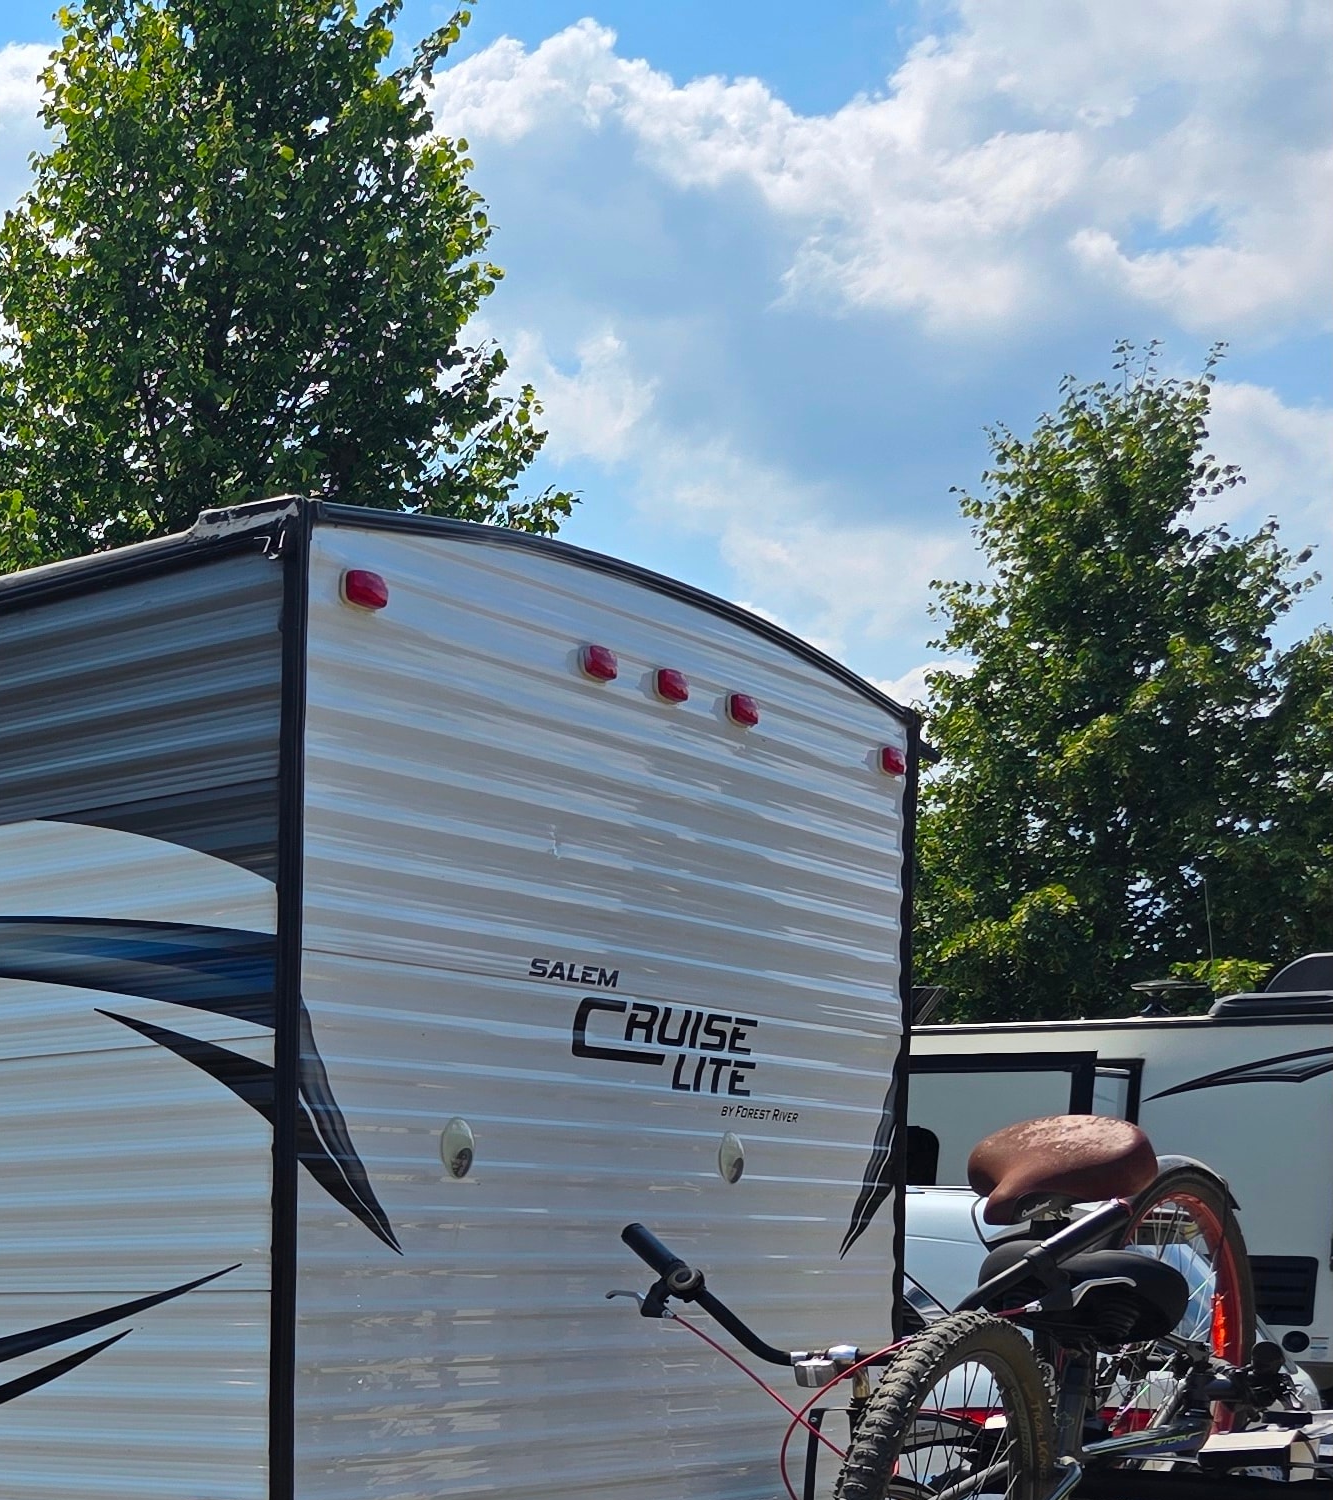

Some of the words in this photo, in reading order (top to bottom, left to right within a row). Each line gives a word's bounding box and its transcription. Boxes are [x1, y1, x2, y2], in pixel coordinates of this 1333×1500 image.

[528, 958, 620, 988] SALEM
[571, 996, 759, 1066] CRUISE
[671, 1053, 757, 1097] LITE
[720, 1105, 734, 1117] BY
[735, 1105, 771, 1120] FOREST
[772, 1108, 799, 1123] RIVER
